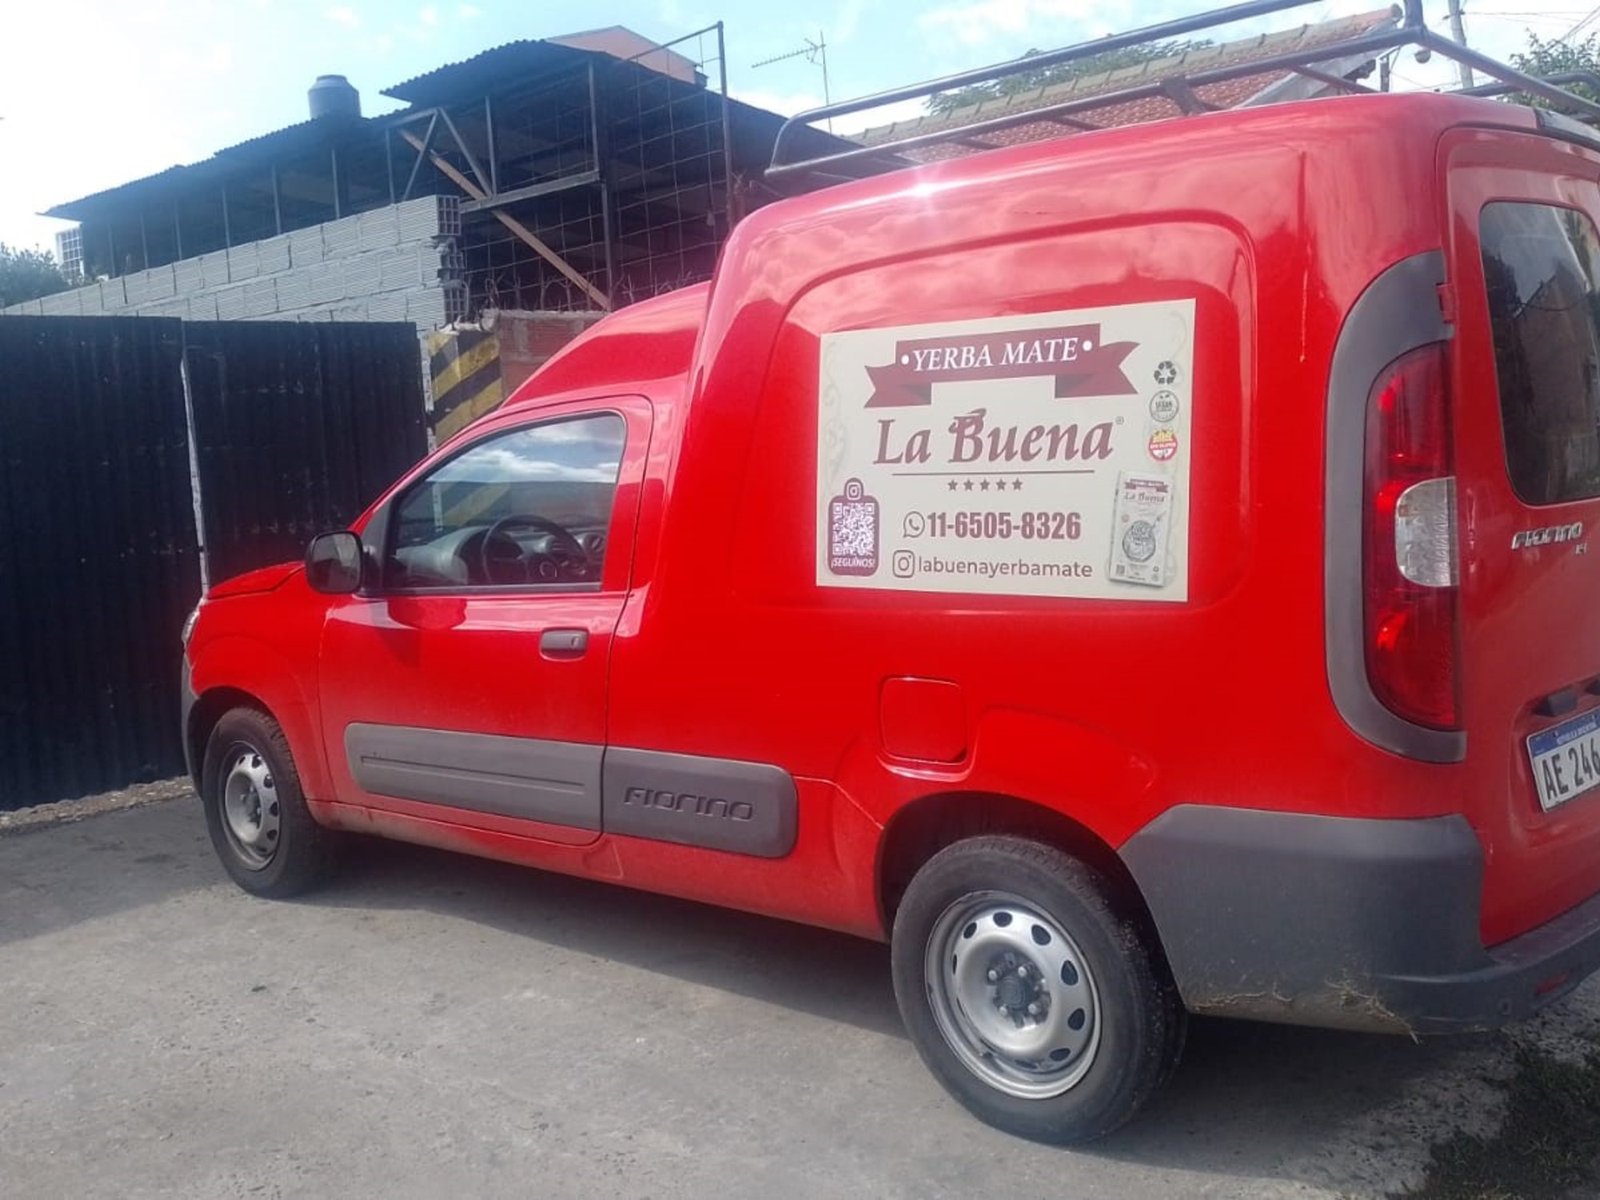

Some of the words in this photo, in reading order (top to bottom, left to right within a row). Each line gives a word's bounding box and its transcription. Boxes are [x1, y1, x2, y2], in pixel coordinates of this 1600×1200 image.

[911, 344, 992, 372] YERBA
[1000, 337, 1079, 364] MATE
[872, 418, 931, 465] La
[948, 408, 1114, 465] Buena
[927, 511, 1081, 539] 11-6505-8326
[918, 553, 1093, 581] labuenayerbamate
[1542, 753, 1569, 801] AE
